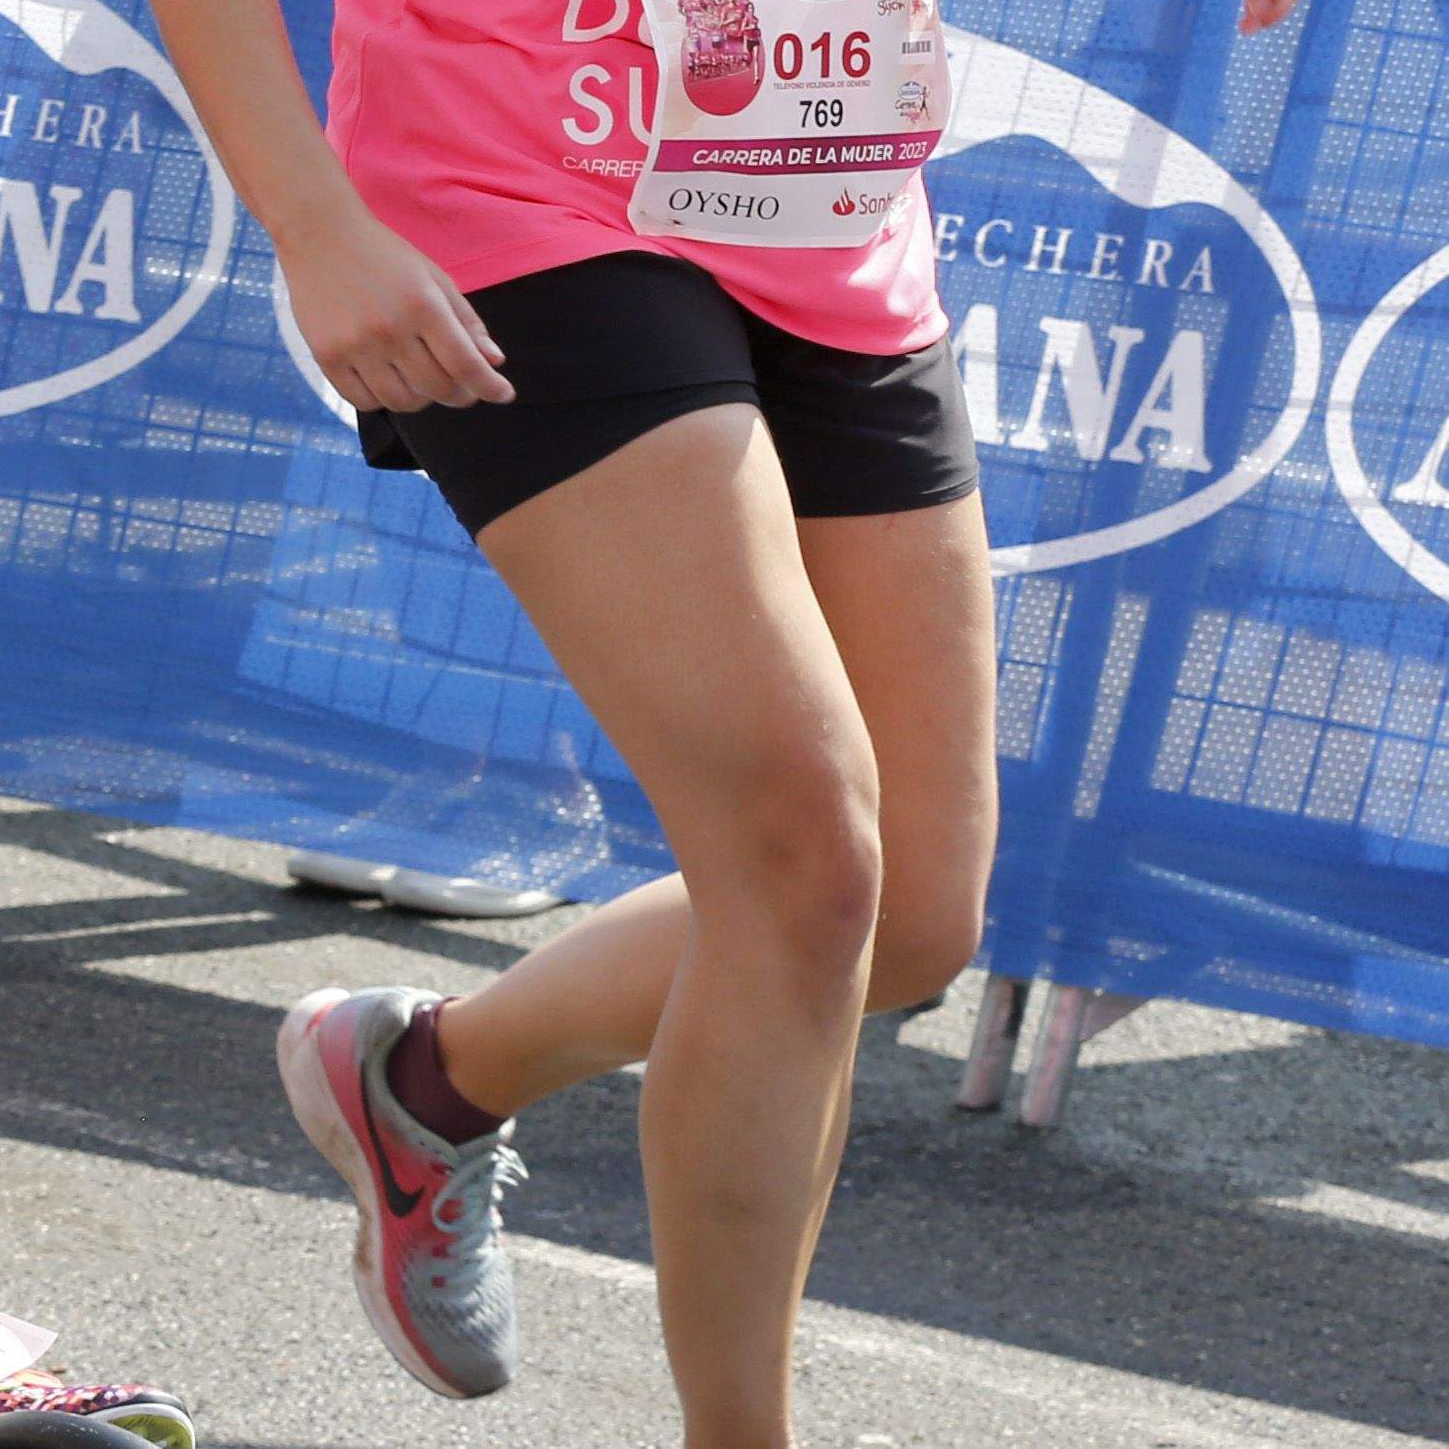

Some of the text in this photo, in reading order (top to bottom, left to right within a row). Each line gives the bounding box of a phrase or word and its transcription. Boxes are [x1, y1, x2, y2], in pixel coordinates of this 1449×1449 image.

[774, 31, 871, 80] 016
[800, 99, 843, 128] 769
[692, 141, 927, 166] CARRERA DE LA MUJER 2023
[668, 188, 780, 220] OYSHO
[933, 213, 1216, 294] ECHERA
